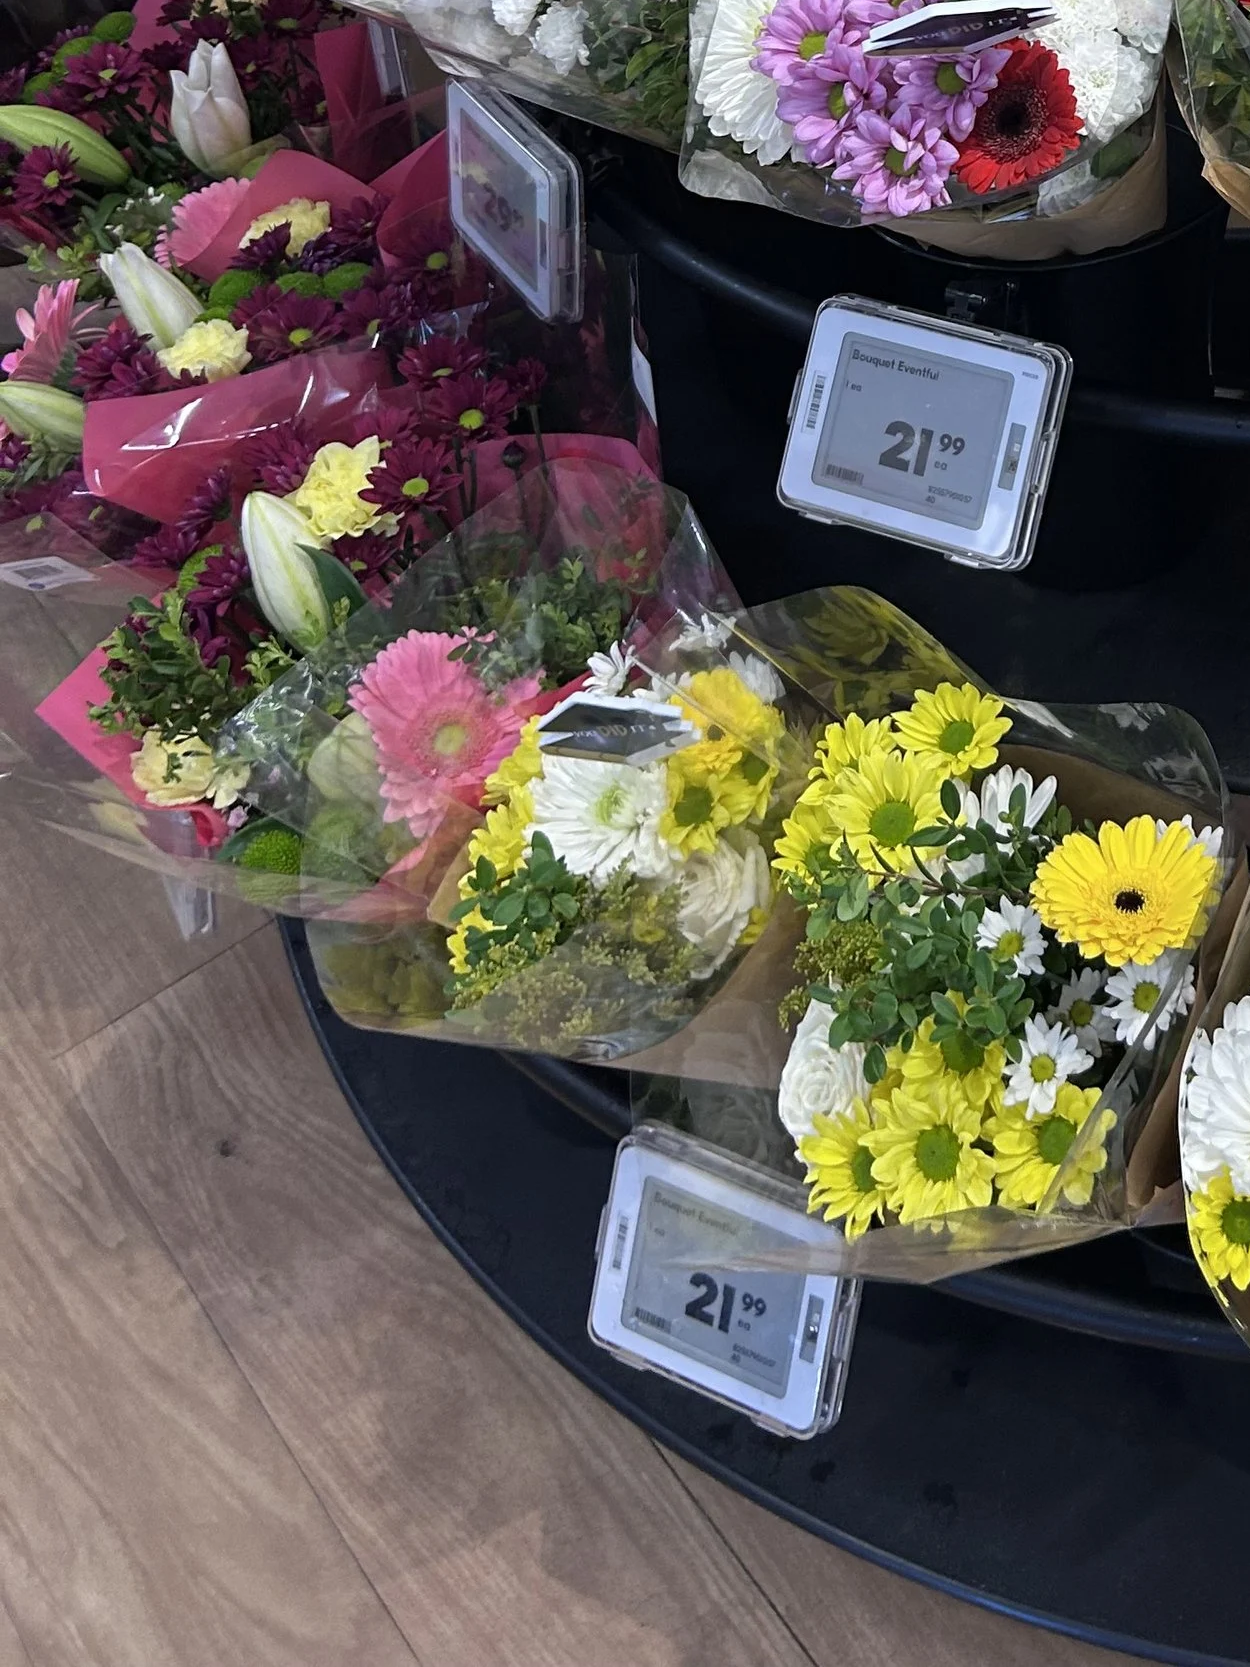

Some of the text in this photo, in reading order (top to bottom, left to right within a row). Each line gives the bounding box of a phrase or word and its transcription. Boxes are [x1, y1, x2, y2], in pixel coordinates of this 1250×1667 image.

[948, 21, 984, 35] DID
[852, 349, 939, 382] Bouquet Eventful
[879, 420, 966, 477] 21 99
[934, 461, 948, 471] ea
[597, 724, 628, 738] DID
[653, 1191, 696, 1218] Bouquet
[685, 1272, 767, 1334] 21 99
